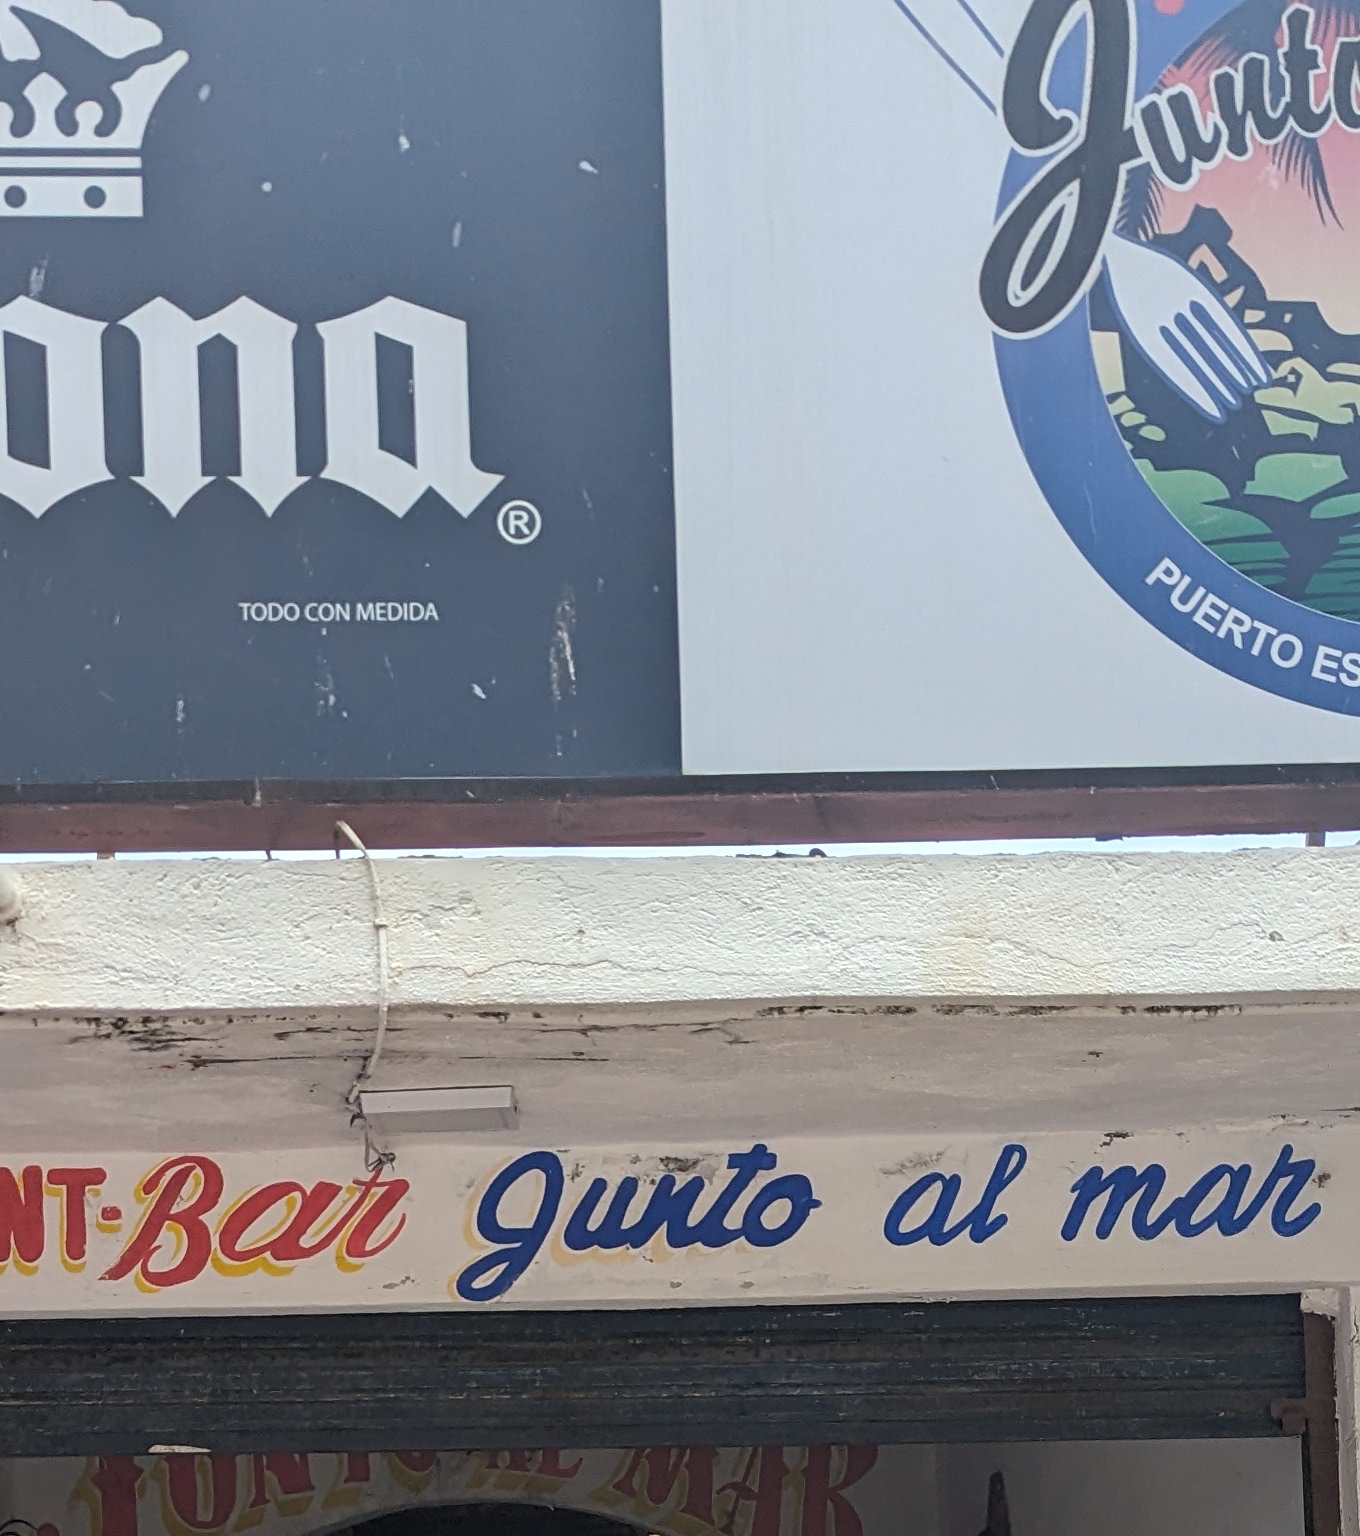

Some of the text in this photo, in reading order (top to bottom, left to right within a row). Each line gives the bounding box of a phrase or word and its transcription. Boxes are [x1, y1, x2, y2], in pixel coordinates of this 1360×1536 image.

[238, 601, 440, 622] TODO CON MEDIDA
[1143, 556, 1304, 669] PUERTO
[883, 1143, 1029, 1247] al
[1059, 1143, 1322, 1242] mar
